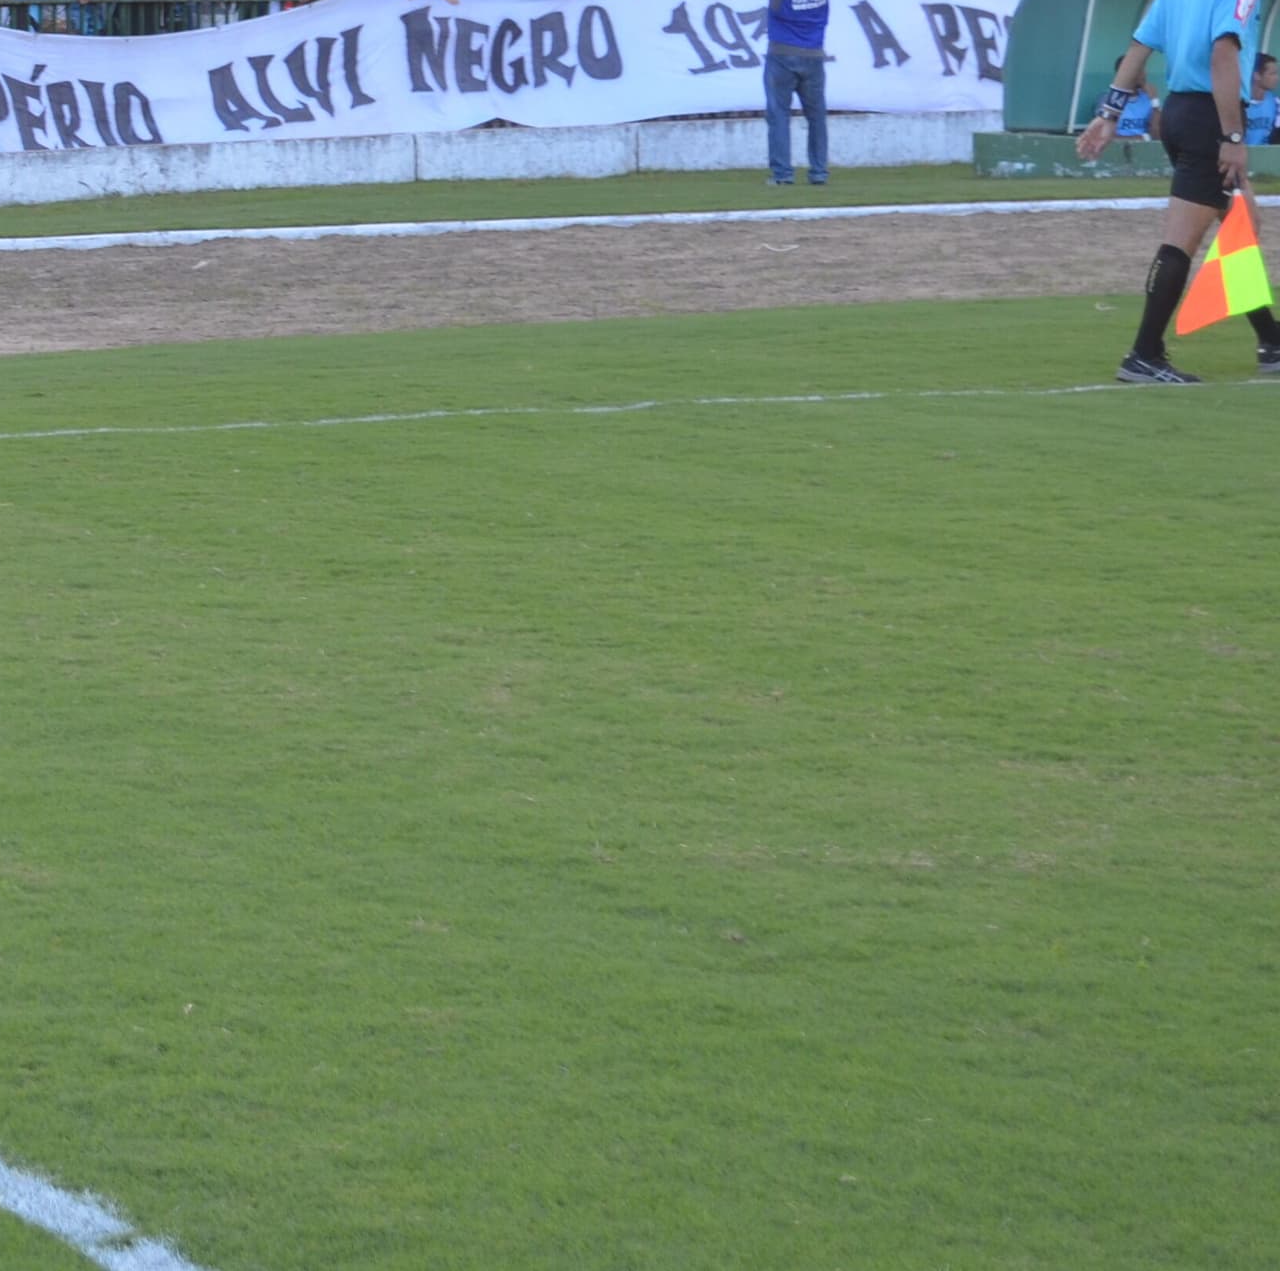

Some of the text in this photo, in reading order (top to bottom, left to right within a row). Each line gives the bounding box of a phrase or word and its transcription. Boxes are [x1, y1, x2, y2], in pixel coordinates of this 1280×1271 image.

[207, 25, 376, 131] ALVI
[399, 5, 624, 97] NEGRO
[850, 0, 912, 69] A
[920, 3, 1014, 83] RE
